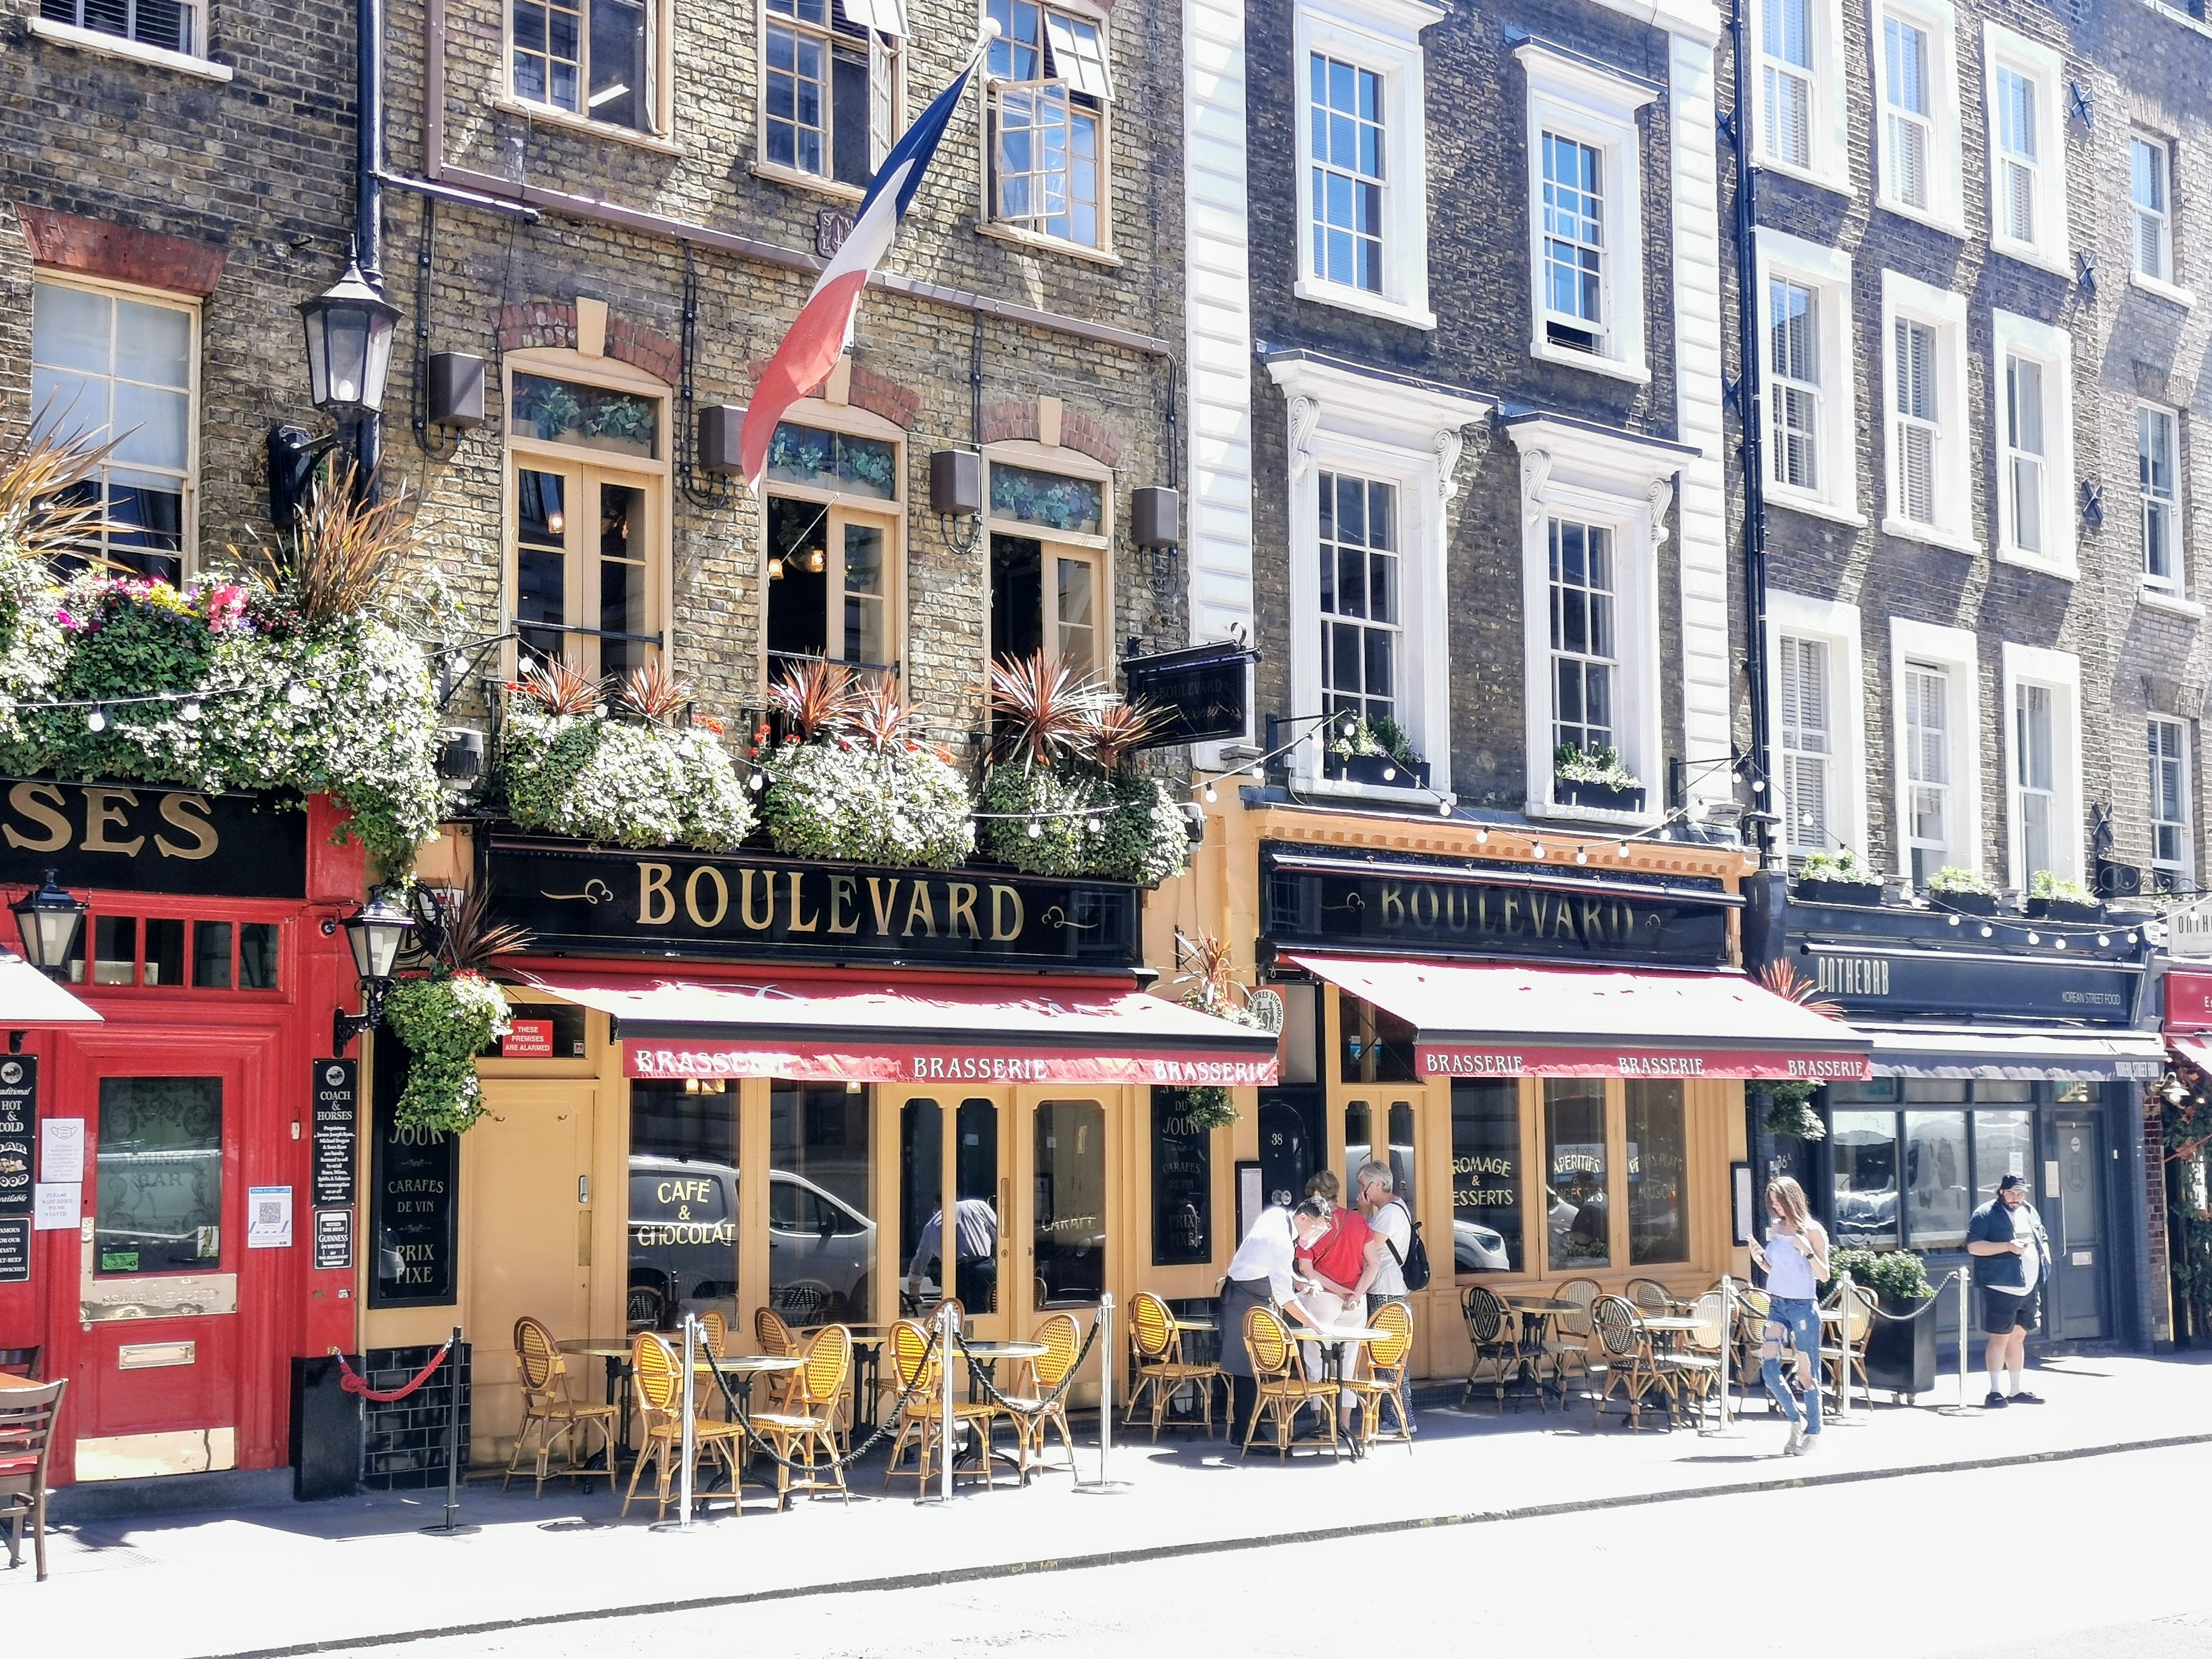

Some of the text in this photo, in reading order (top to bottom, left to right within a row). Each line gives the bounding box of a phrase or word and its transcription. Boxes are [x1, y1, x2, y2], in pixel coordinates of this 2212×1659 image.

[1159, 679, 1222, 699] BOULEVARD
[2, 782, 219, 860] SES
[636, 862, 1024, 941] BOULEVARD
[1381, 882, 1635, 940] BOULEVARD
[2062, 991, 2120, 1005] KOREAN STREET FOOD
[913, 1057, 1048, 1080] BRASSERIE
[1153, 1060, 1270, 1082] BRASSERIE
[1426, 1053, 1524, 1074] BRASSERIE
[1618, 1056, 1704, 1075] BRASSERIE
[1788, 1059, 1863, 1078] BRASSERIE
[320, 1091, 350, 1101] COACH
[1, 1101, 22, 1110] HOT
[332, 1101, 341, 1111] &
[1175, 1100, 1188, 1111] DU
[7, 1111, 18, 1121] &
[317, 1111, 353, 1121] HORSES
[1272, 1133, 1283, 1145] 38
[1163, 1162, 1201, 1175] CARAFES
[1452, 1156, 1512, 1177] ROMAGE
[138, 1173, 184, 1187] BAR
[388, 1179, 444, 1194] CARAFES
[1472, 1175, 1480, 1186] &
[657, 1179, 712, 1204] CAFÉ
[1453, 1190, 1513, 1206] ESSERTS
[397, 1201, 434, 1213] DE VIN
[679, 1205, 691, 1221] &
[1168, 1214, 1196, 1228] PRIX
[318, 1234, 348, 1242] GUINNESS
[638, 1224, 736, 1246] CHOCOLAT
[395, 1244, 435, 1262] PRIX
[395, 1266, 434, 1285] FIXE
